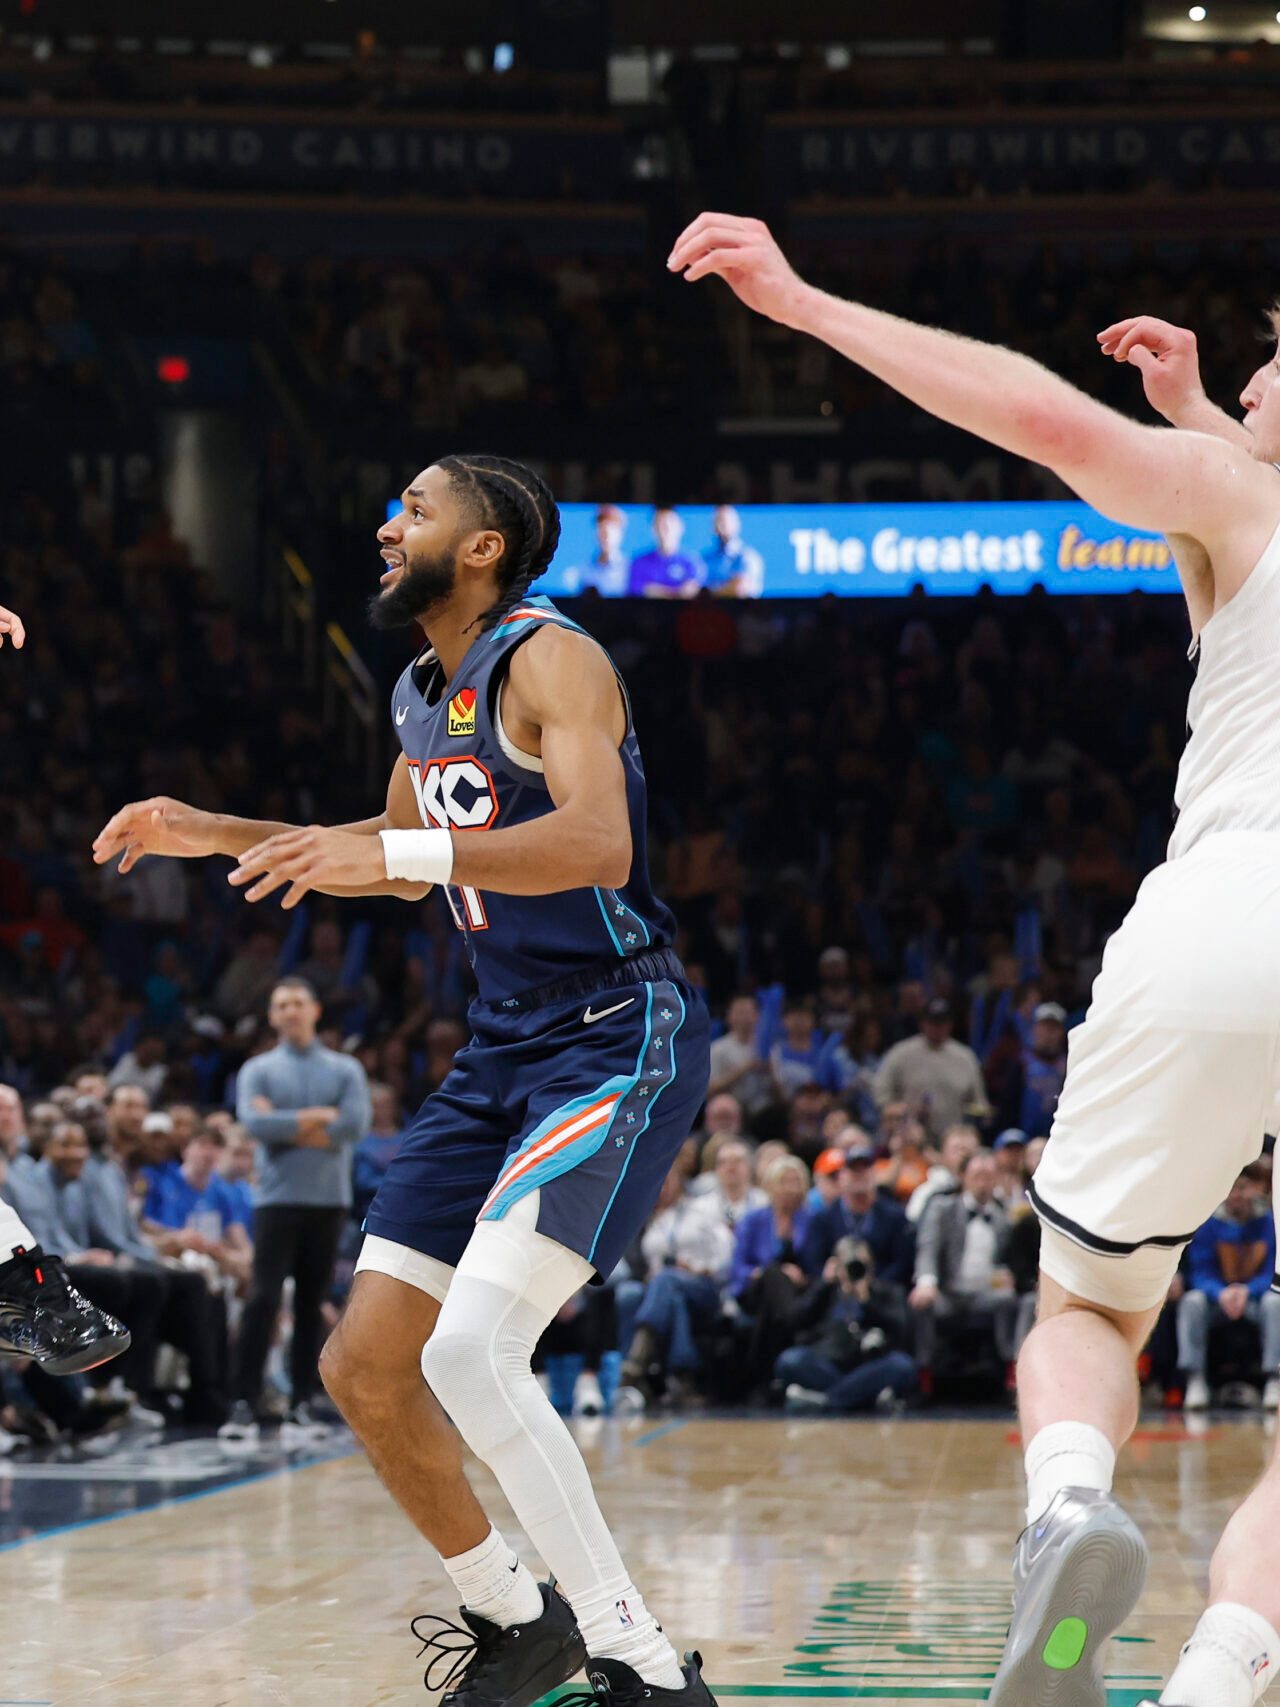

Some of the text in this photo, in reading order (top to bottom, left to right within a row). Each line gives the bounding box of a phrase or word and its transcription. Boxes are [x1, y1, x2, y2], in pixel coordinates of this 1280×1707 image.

[291, 131, 513, 173] CASINO
[801, 127, 1148, 170] RIVERWIND
[788, 527, 866, 575] The
[871, 526, 1043, 574] Greatest
[407, 755, 500, 832] KC
